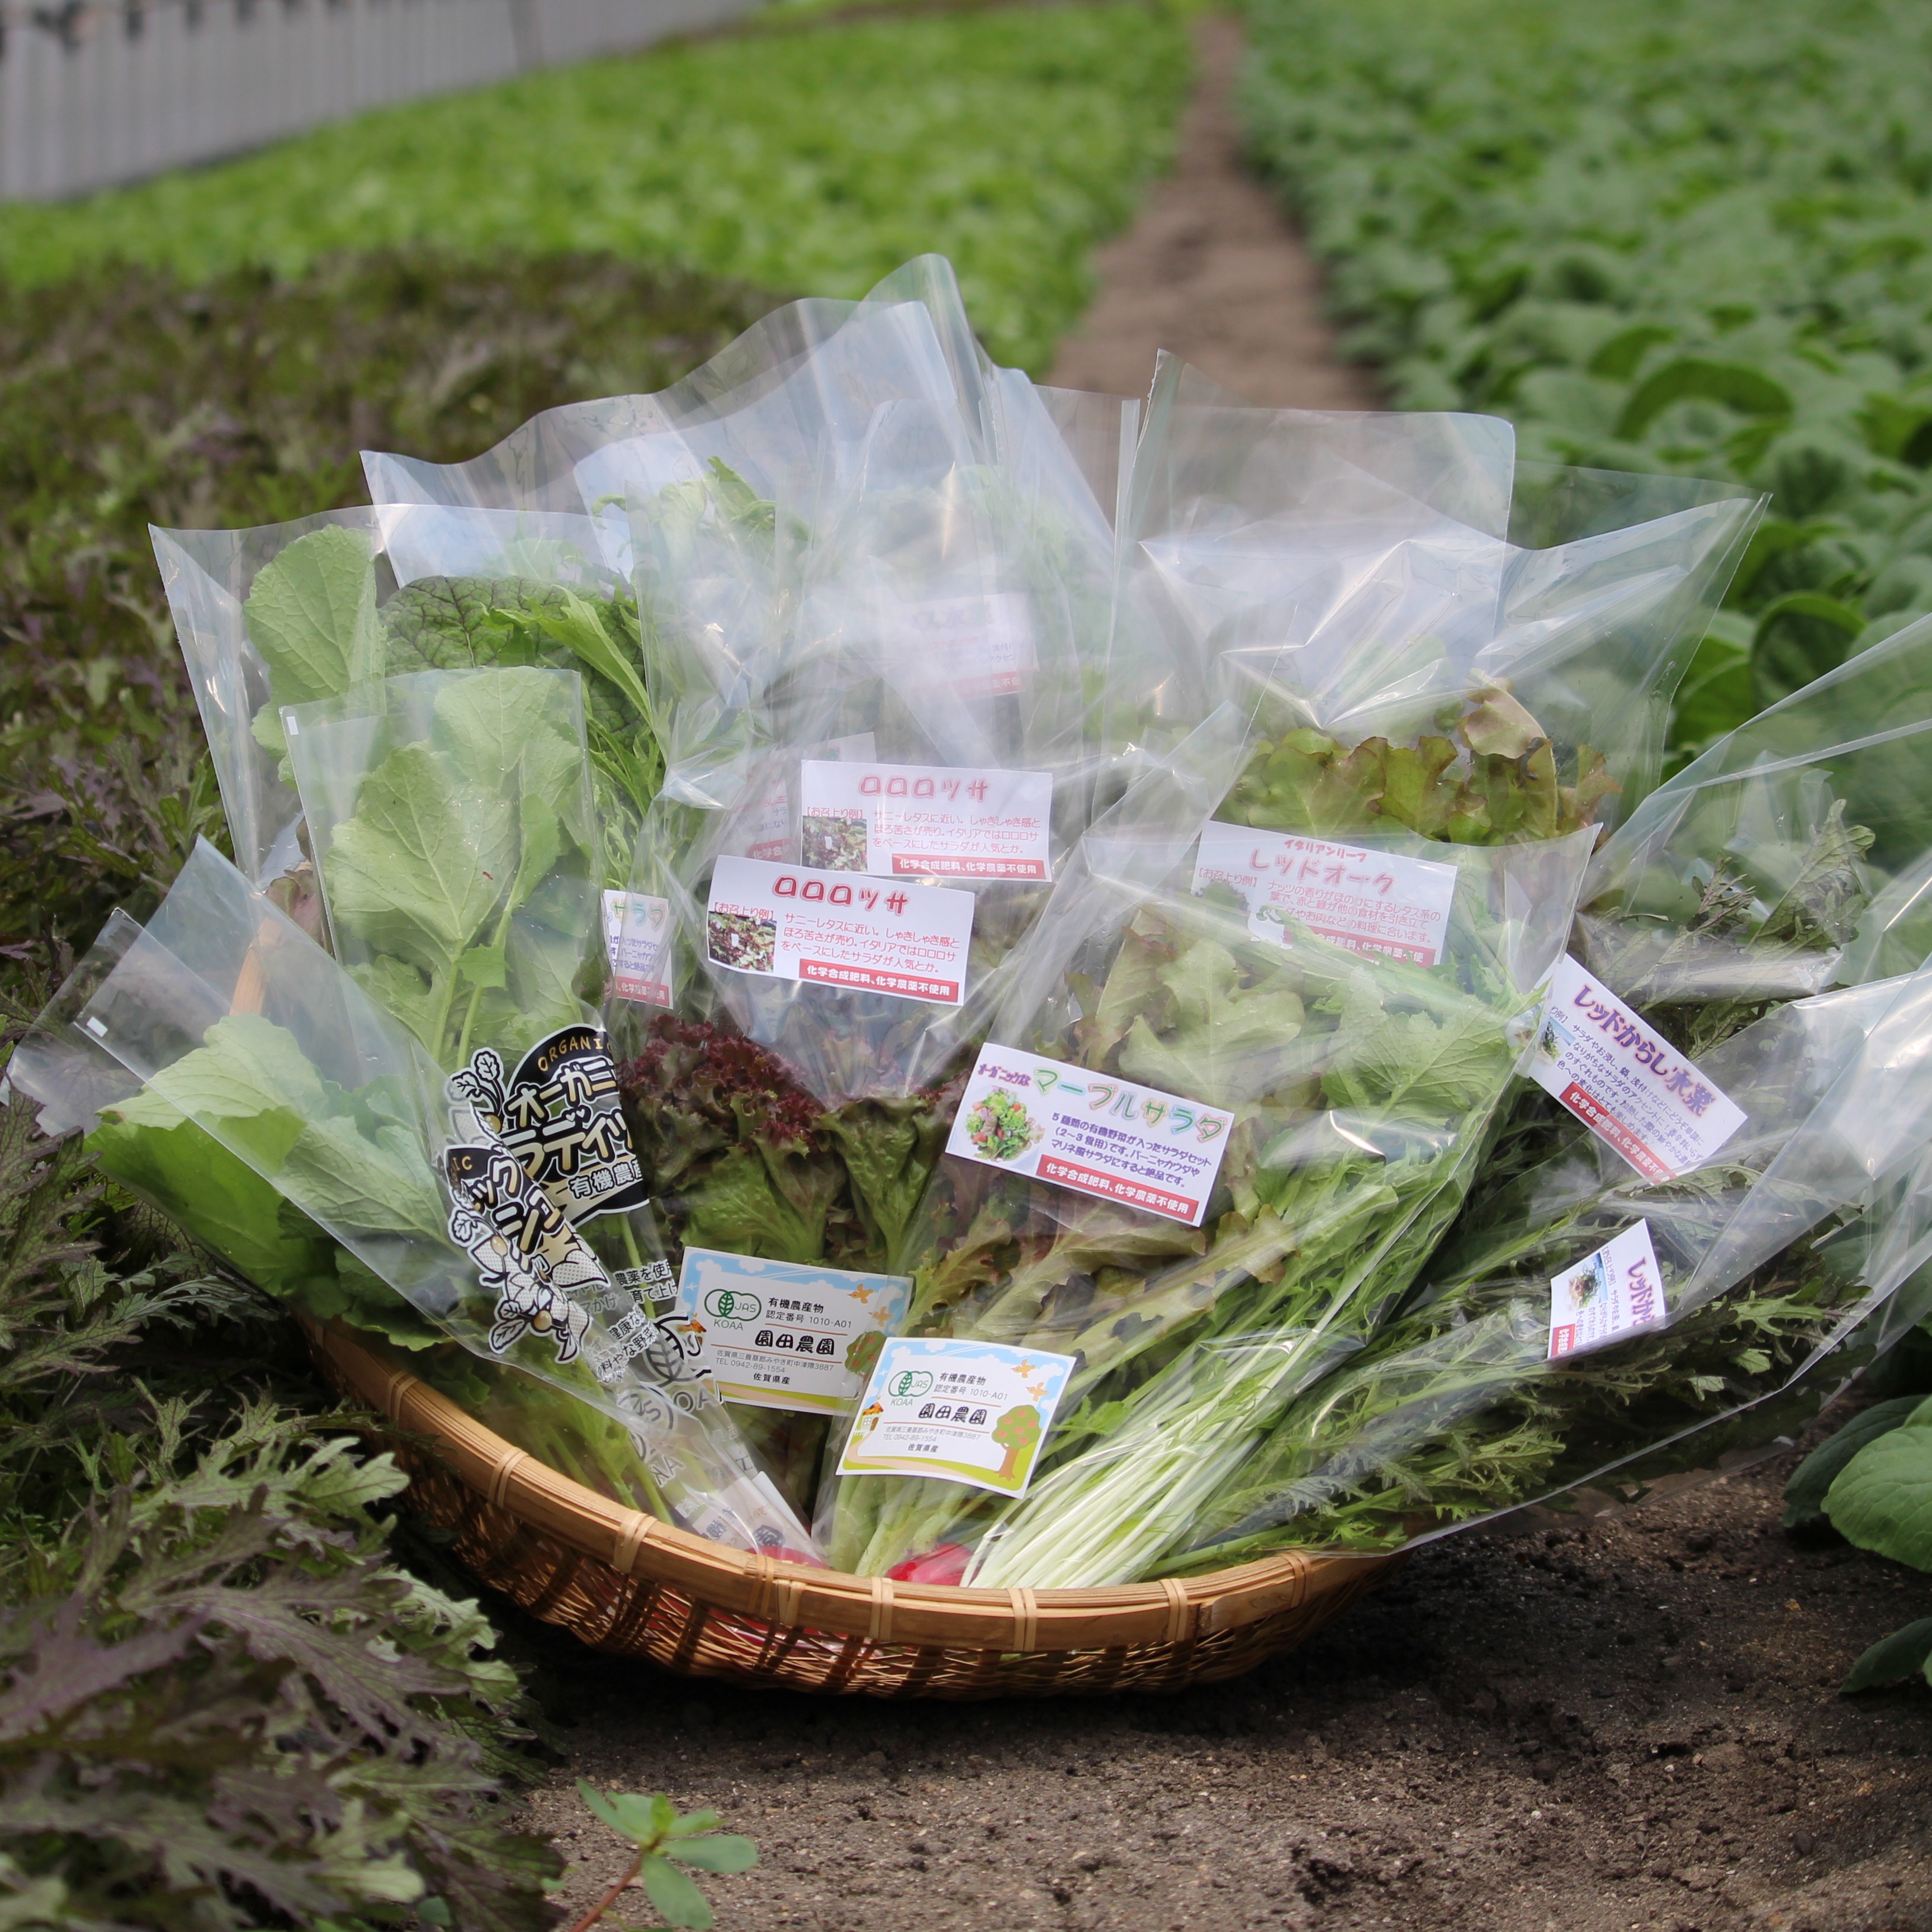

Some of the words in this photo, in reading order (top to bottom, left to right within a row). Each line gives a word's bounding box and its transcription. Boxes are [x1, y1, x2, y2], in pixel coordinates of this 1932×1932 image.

[807, 965, 950, 996] 化学合成肥料、化学農薬不使用
[1046, 1162, 1190, 1215] 化学合成肥料、化学農薬不使用
[768, 1297, 824, 1314] 有機農産物
[713, 1318, 744, 1332] KOAA
[766, 1310, 805, 1324] 認定番号
[809, 1316, 852, 1329] 1010-A01
[755, 1329, 835, 1356] 園田農園
[716, 1357, 728, 1366] TEL
[731, 1360, 785, 1374] 0942-89-1554
[753, 1372, 791, 1385] 佐賀県産
[939, 1371, 987, 1386] 有機農産物
[933, 1384, 967, 1396] 認定番号
[969, 1388, 1008, 1401] 1010-A01
[918, 1403, 988, 1426] 園田農園
[907, 1443, 939, 1453] 佐賀県産
